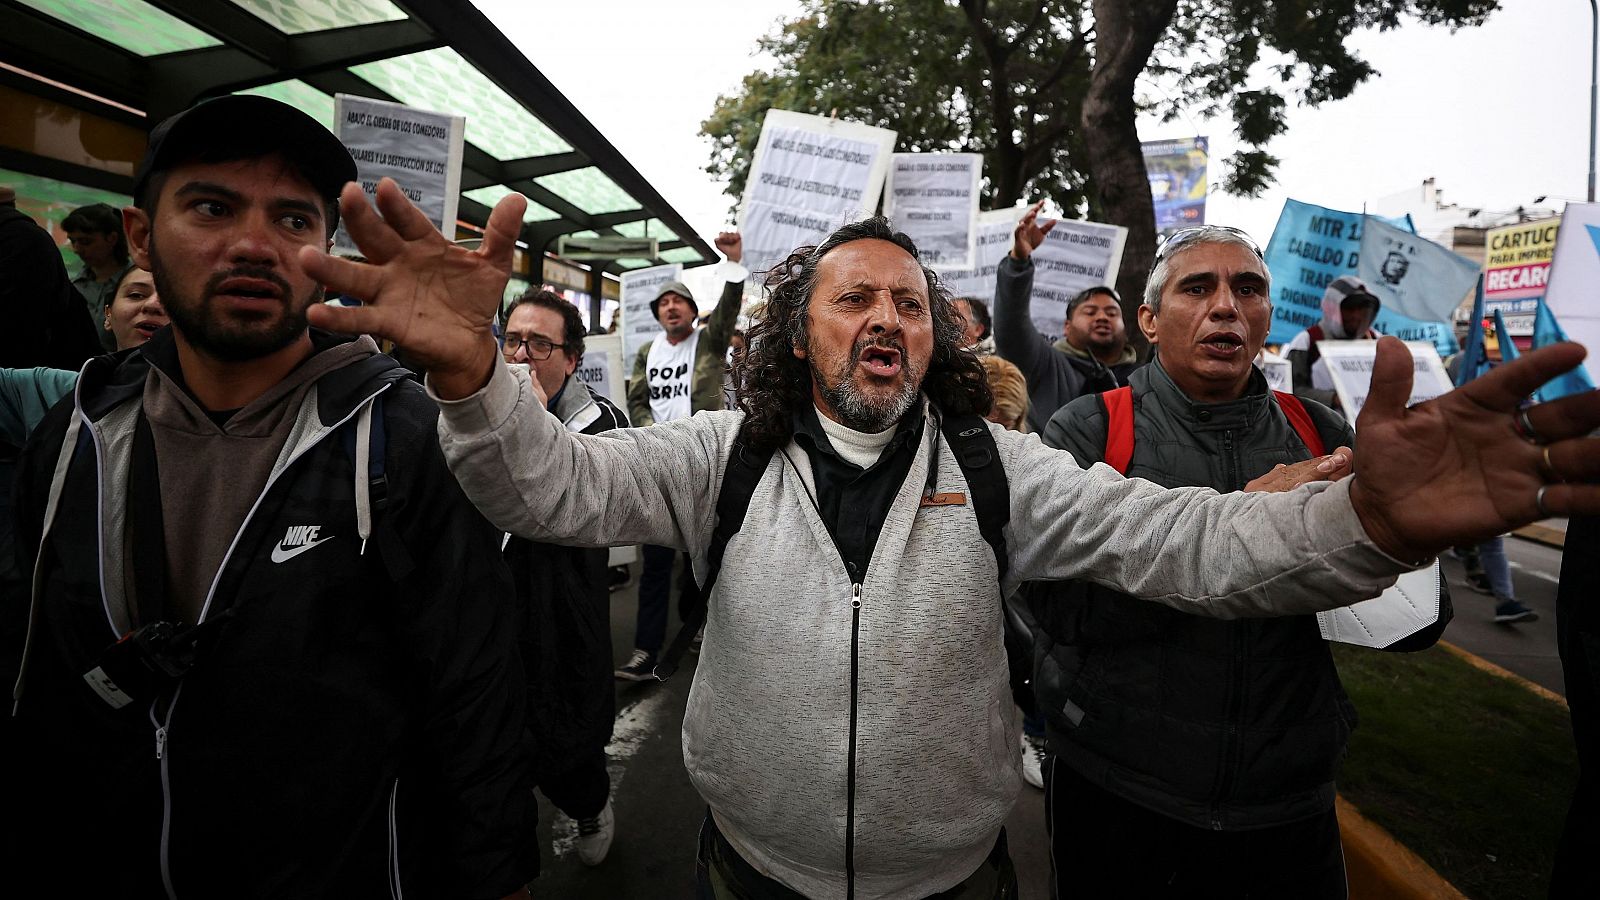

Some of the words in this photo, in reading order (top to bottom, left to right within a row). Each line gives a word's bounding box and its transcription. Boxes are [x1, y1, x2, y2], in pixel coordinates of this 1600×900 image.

[347, 112, 365, 125] ABAJO
[366, 114, 372, 127] EL
[373, 116, 391, 129] CIERRE
[392, 119, 400, 131] DE
[401, 121, 411, 133] LOS
[412, 122, 445, 139] COMEDORES
[347, 147, 374, 163] OPULARES
[380, 153, 387, 165] LA
[425, 161, 433, 172] DE
[433, 162, 444, 175] LOS
[1309, 215, 1344, 238] MTR
[1348, 223, 1361, 241] 1
[1288, 237, 1344, 266] CABILDO
[1348, 252, 1360, 269] D
[1281, 286, 1321, 310] DIGNID
[577, 368, 602, 382] DORES
[282, 526, 321, 545] NIKE
